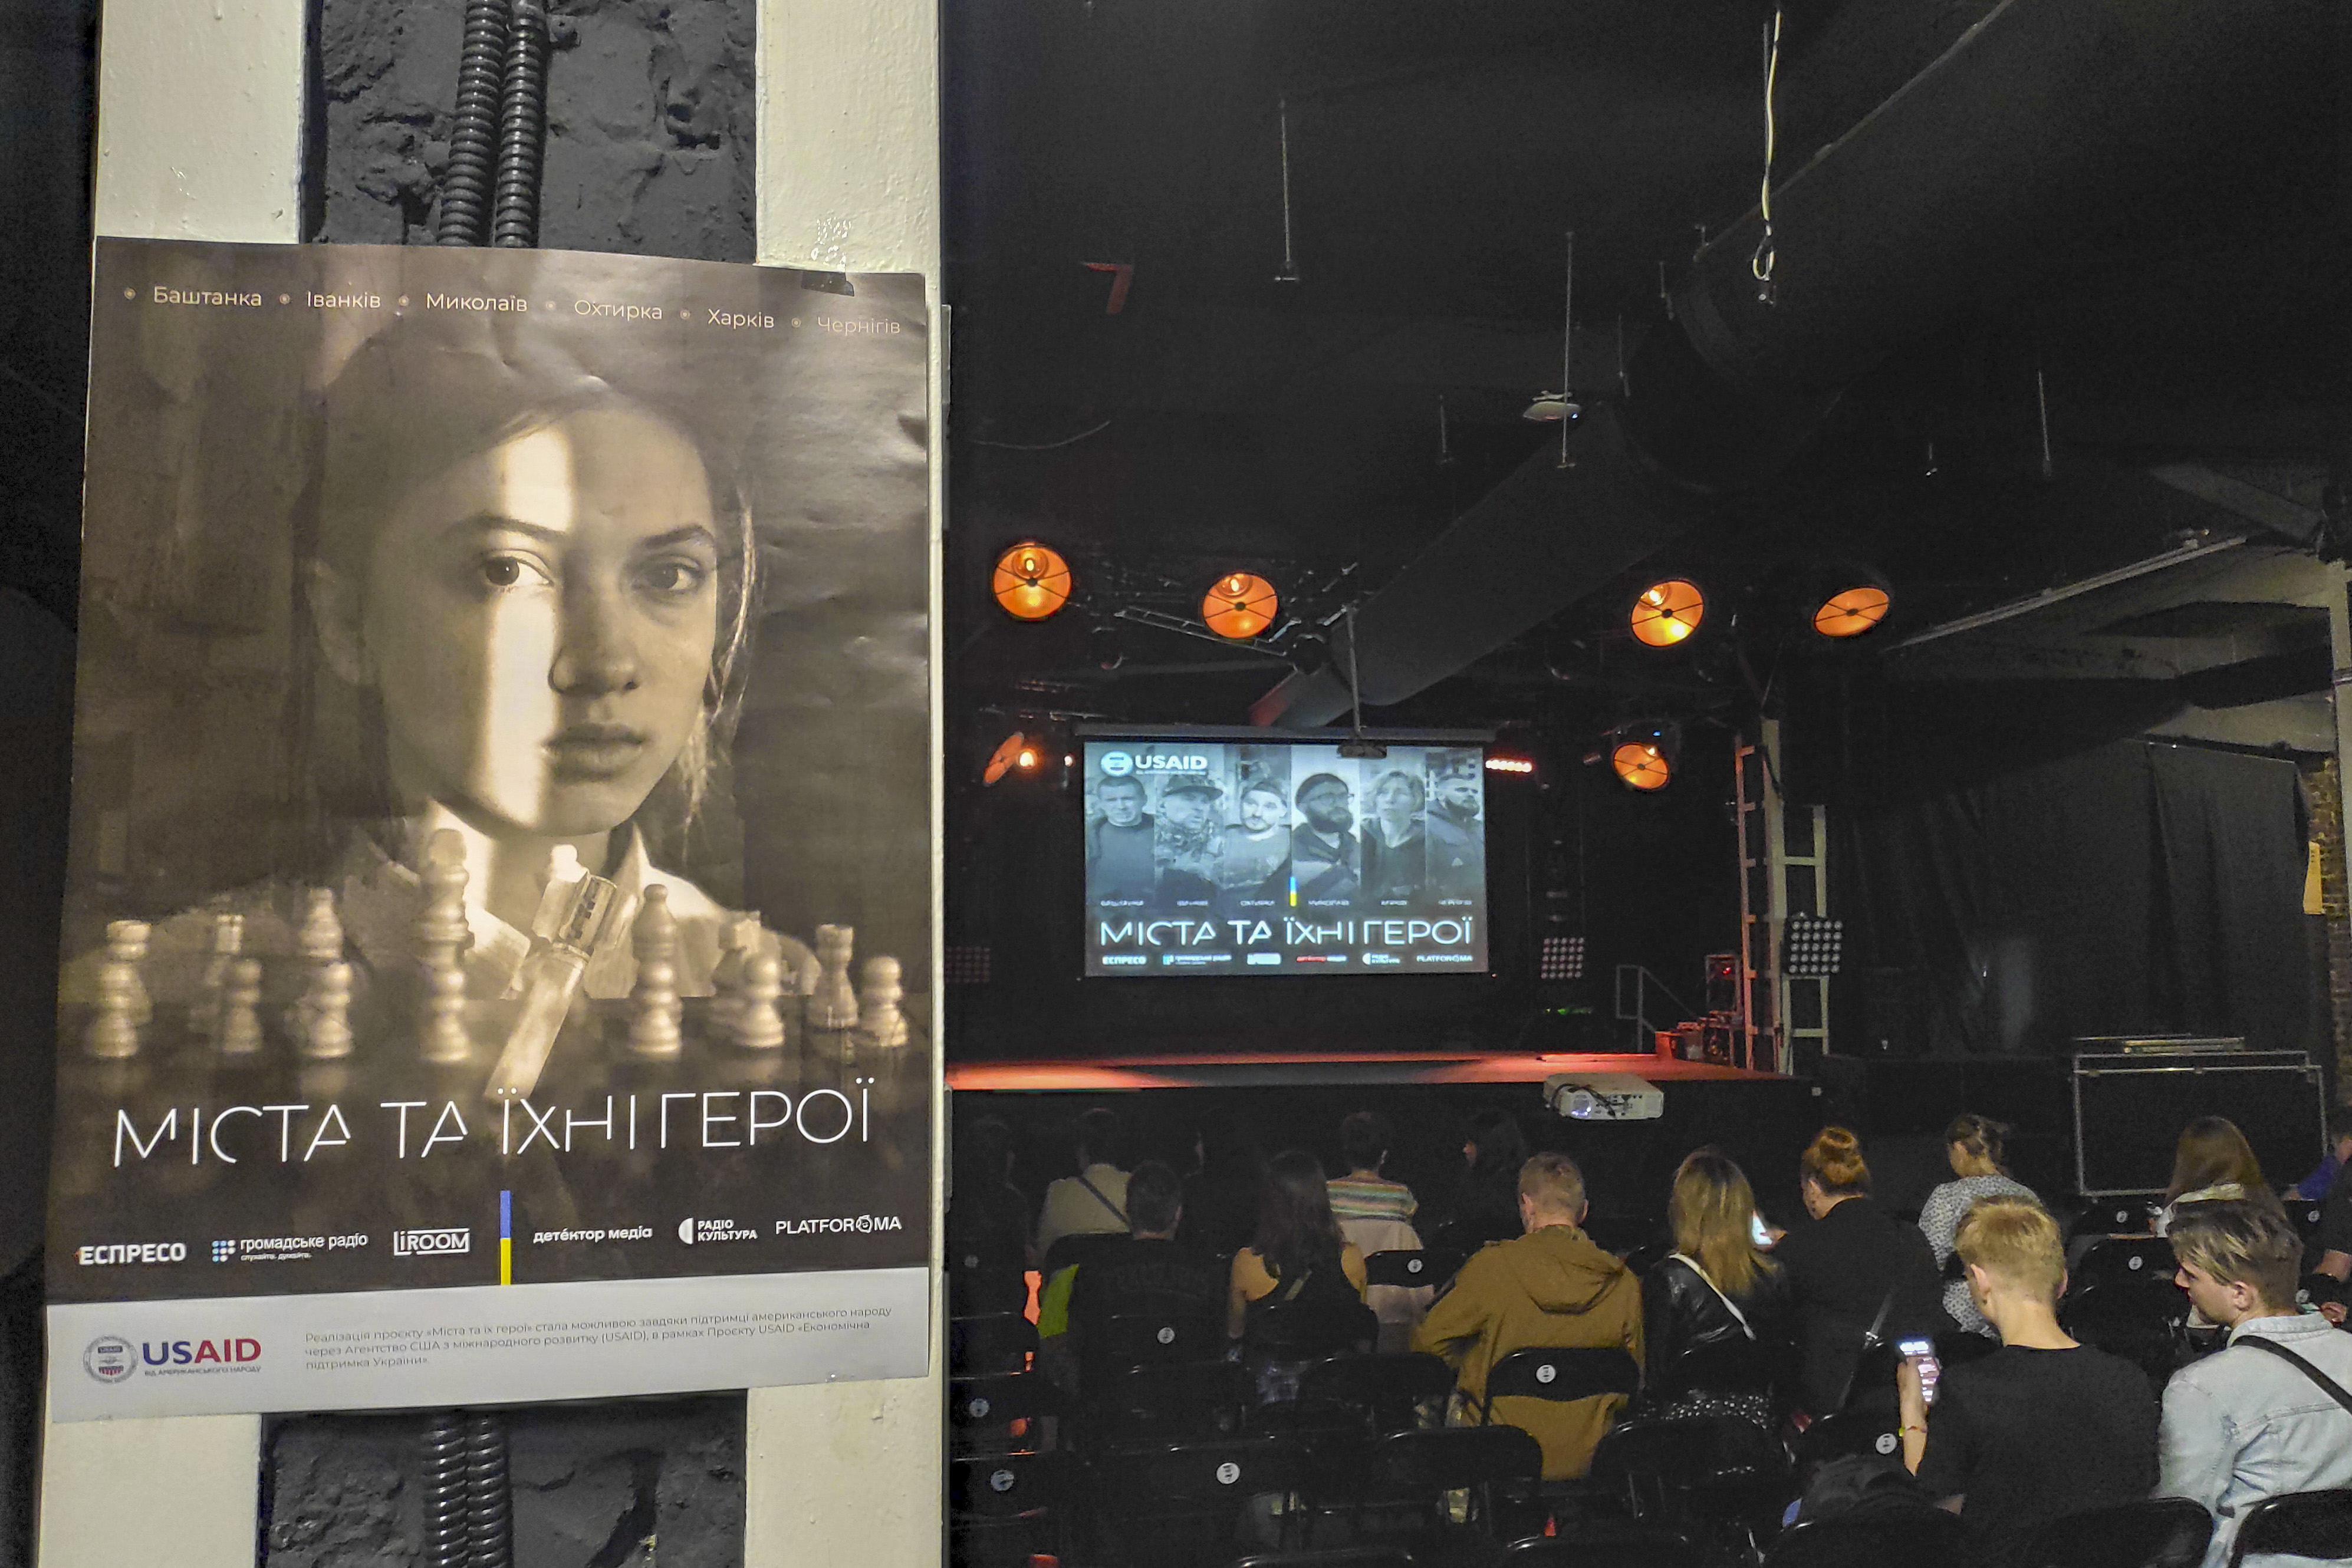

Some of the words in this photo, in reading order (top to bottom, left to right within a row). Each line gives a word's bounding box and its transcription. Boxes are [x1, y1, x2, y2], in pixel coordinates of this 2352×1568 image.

[153, 285, 262, 307] Баштанка
[307, 290, 381, 309] Іванків
[426, 292, 528, 313] Миколаїв
[574, 299, 663, 321] Охтирка
[708, 308, 775, 329] Харків
[817, 315, 901, 336] Чернігів
[1134, 755, 1208, 770] USAID
[1100, 920, 1216, 946] МІСТА
[1226, 920, 1272, 946] ТА
[1283, 915, 1354, 945] ЇХНІ
[1363, 915, 1473, 945] ГЕРОЇ
[113, 1103, 351, 1168] МІСТА
[380, 1100, 469, 1159] ТА
[497, 1087, 636, 1155] ЇХНІ
[660, 1076, 876, 1149] ГЕРОЇ
[608, 1225, 653, 1240] медіа
[697, 1219, 735, 1231] РАДІО
[697, 1230, 758, 1242] КУЛЬТУРА
[79, 1242, 187, 1266] ЕСПРЕСО
[240, 1236, 325, 1253] громадське
[328, 1231, 369, 1251] радіо
[305, 1332, 370, 1343] Реалізація
[426, 1326, 465, 1338] «Міста
[468, 1327, 481, 1336] та
[535, 1323, 568, 1332] стала
[571, 1319, 636, 1330] можливою
[640, 1316, 687, 1327] завдяки
[691, 1313, 749, 1326] підтримці
[752, 1309, 847, 1323] американського
[850, 1307, 892, 1318] народу
[142, 1338, 262, 1365] USAID
[305, 1346, 342, 1358] через
[345, 1343, 407, 1355] Агентство
[410, 1341, 441, 1351] США
[453, 1336, 541, 1350] міжнародного
[544, 1335, 598, 1349] розвитку
[601, 1330, 649, 1344] (USAID),
[662, 1329, 704, 1341] рамках
[759, 1325, 795, 1334] USAID
[798, 1321, 870, 1332] «Економічна
[306, 1359, 370, 1371] підтримка
